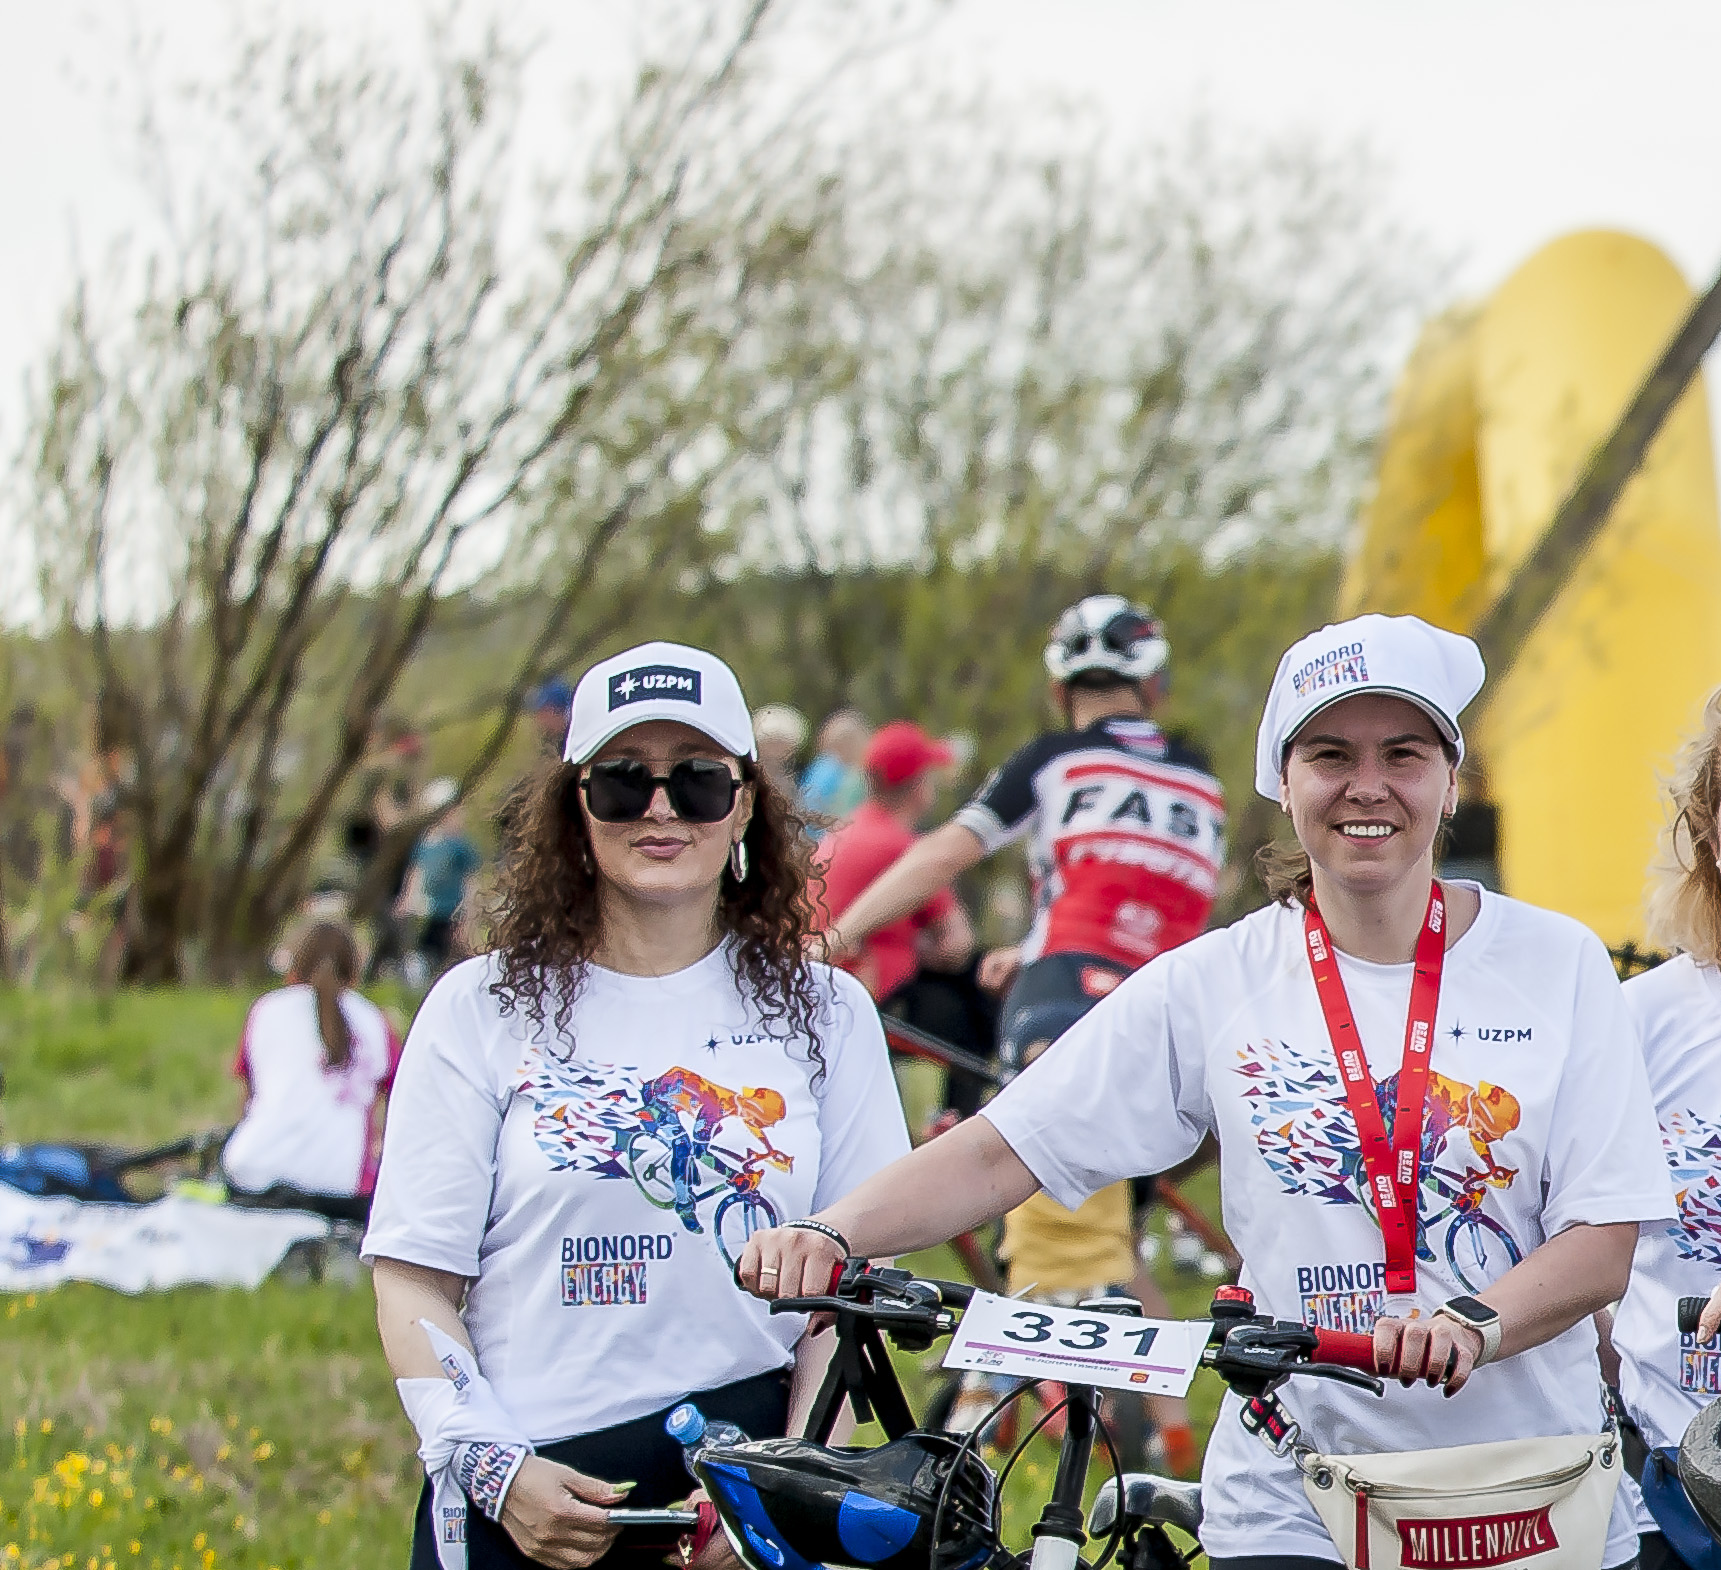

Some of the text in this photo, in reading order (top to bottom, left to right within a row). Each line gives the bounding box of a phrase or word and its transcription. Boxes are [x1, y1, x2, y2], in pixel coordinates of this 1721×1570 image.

[1293, 642, 1363, 690] BIONORD
[643, 675, 692, 691] UZPM
[1478, 1027, 1532, 1042] UZPM
[561, 1234, 673, 1262] BIONORD
[562, 1262, 646, 1305] ENERGY
[1297, 1261, 1386, 1293] BIONOR
[1003, 1311, 1159, 1357] 331
